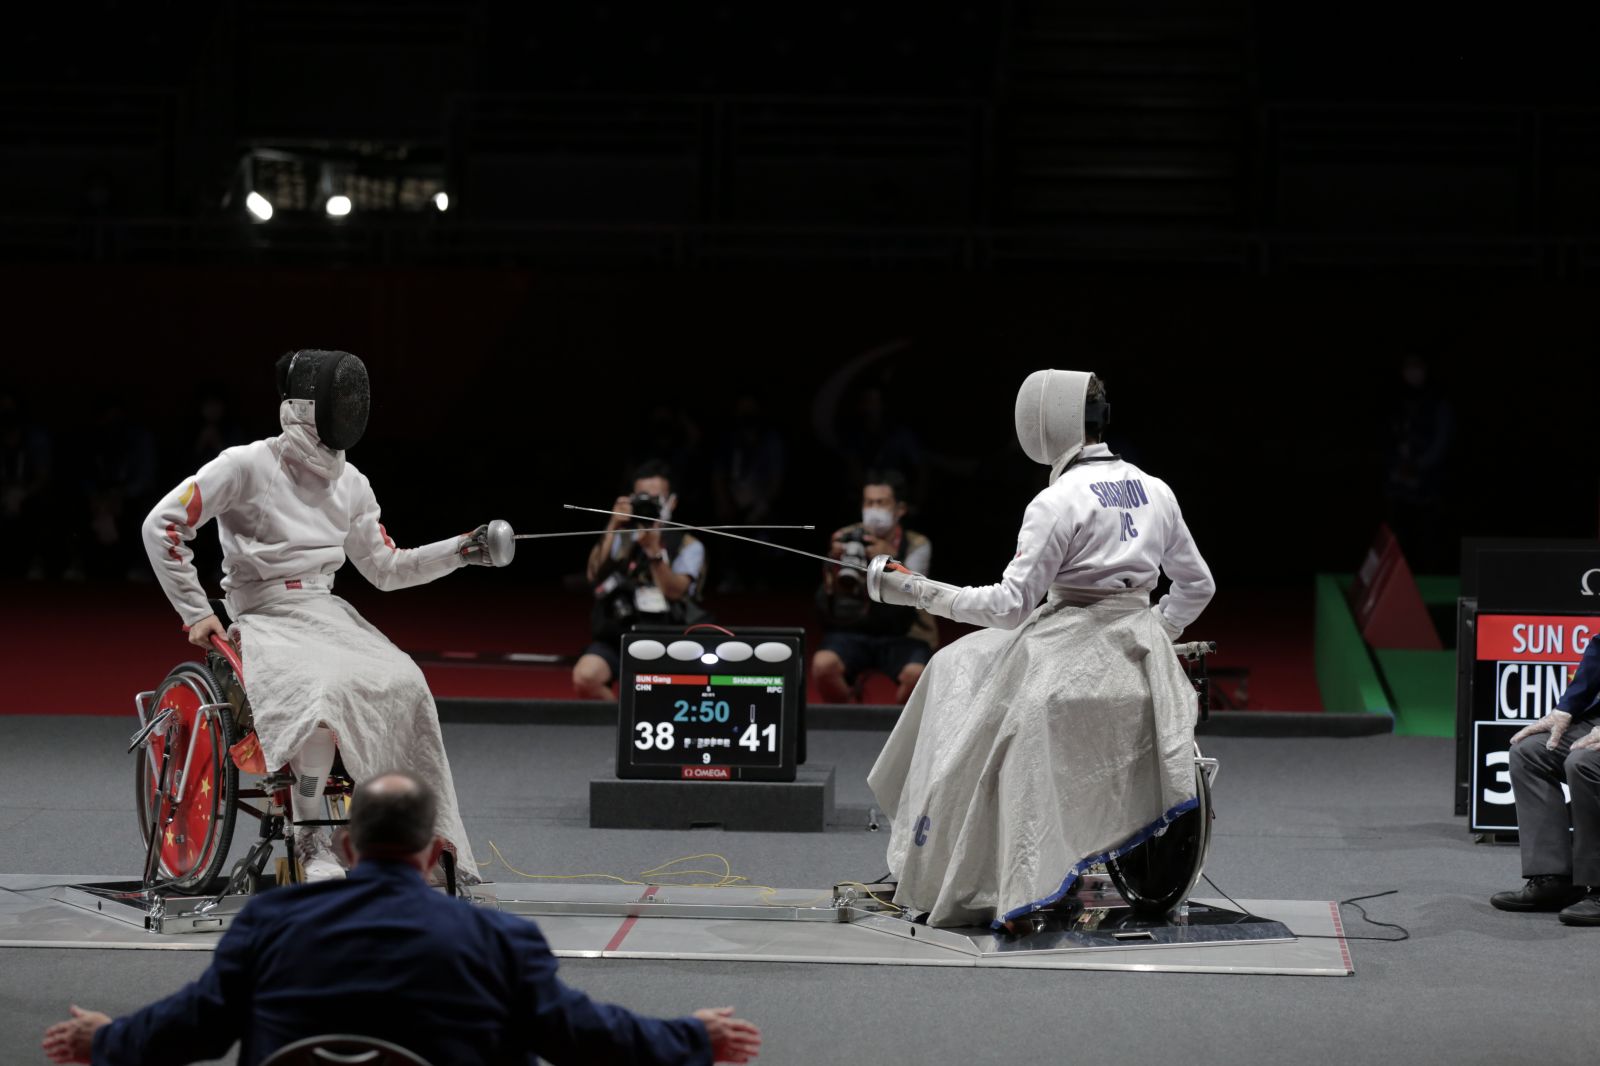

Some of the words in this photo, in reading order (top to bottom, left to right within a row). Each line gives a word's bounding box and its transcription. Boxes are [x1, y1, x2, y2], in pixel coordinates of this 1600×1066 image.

[1512, 623, 1564, 654] SUN
[635, 684, 652, 692] CHN
[766, 686, 783, 694] RPC
[673, 700, 730, 723] 2:50
[635, 721, 675, 751] 38
[738, 723, 777, 752] 41
[702, 752, 711, 764] 9
[694, 769, 728, 777] OMEGA
